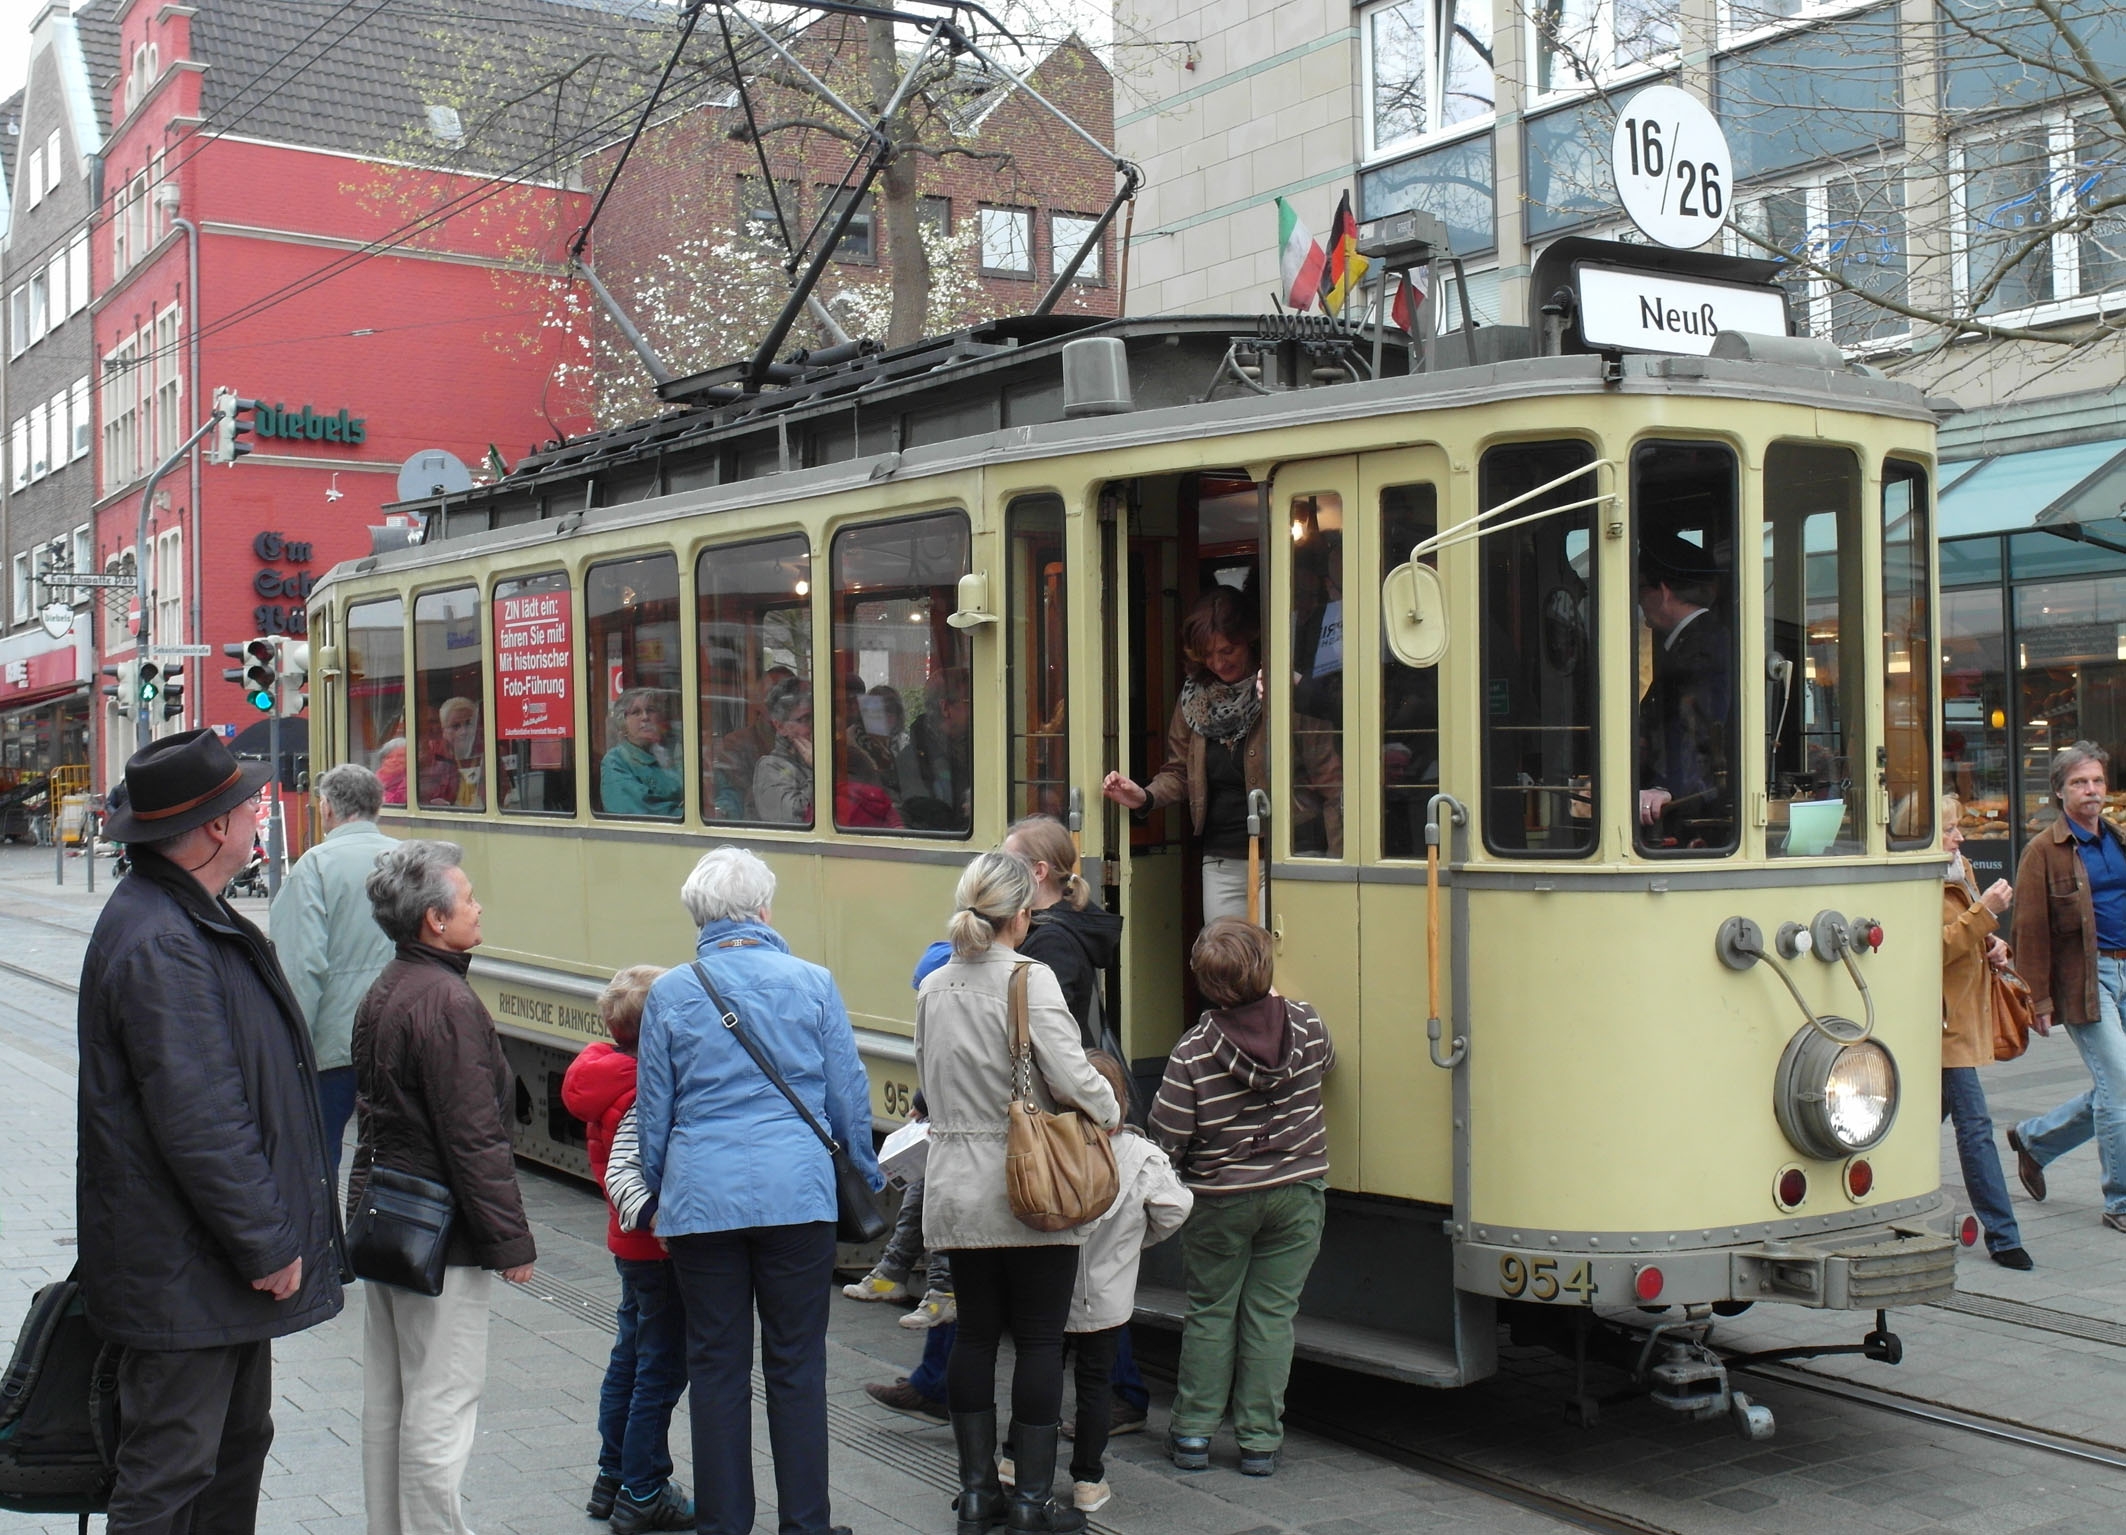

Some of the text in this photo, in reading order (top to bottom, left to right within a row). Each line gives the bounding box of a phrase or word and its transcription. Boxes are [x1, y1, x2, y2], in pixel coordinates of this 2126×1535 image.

[1638, 294, 1719, 337] Neuß
[505, 596, 559, 620] ZIN lädt ein:
[501, 622, 566, 649] fahren Sie mit!
[499, 647, 570, 672] Mit historischer
[503, 675, 565, 699] Foto-Führung
[1968, 859, 2003, 870] enuss
[499, 993, 554, 1025] RHEINISCHE
[883, 1080, 914, 1118] 95
[1499, 1253, 1599, 1305] 954
